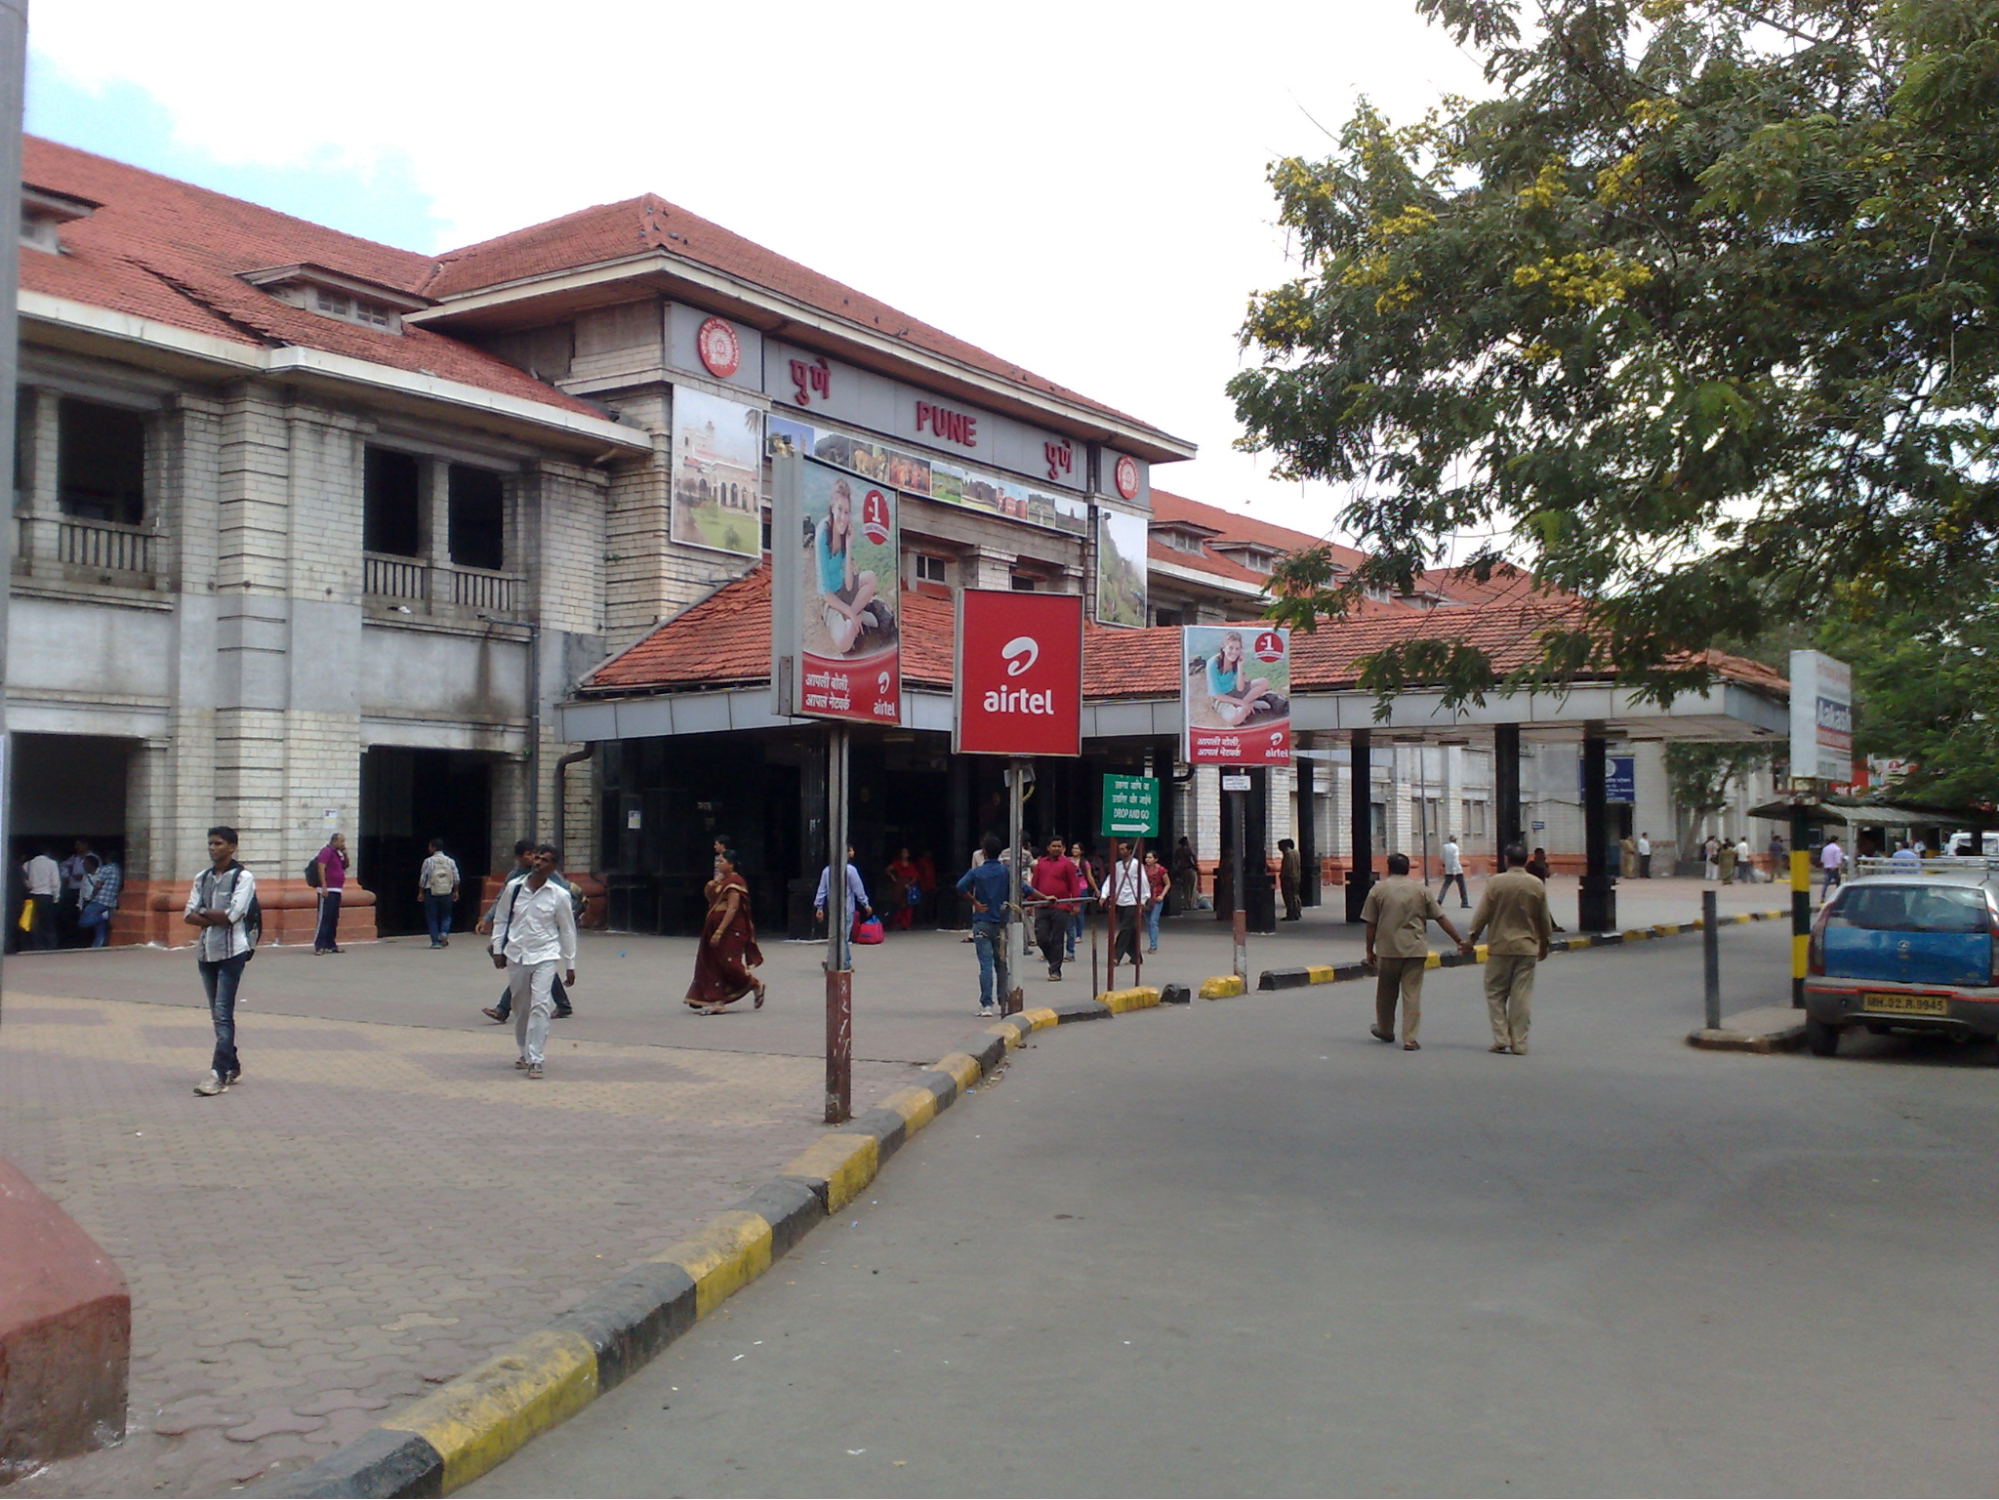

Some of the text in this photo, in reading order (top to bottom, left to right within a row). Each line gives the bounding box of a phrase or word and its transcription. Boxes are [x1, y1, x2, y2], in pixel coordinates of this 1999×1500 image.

[789, 356, 831, 406] पुणे
[916, 400, 977, 447] PUNE
[1044, 438, 1073, 481] पुणे
[805, 671, 830, 689] आपली
[873, 698, 896, 717] airtel
[983, 684, 1055, 715] airtel
[1265, 748, 1289, 758] airtel
[1113, 808, 1150, 820] DROP AND GO
